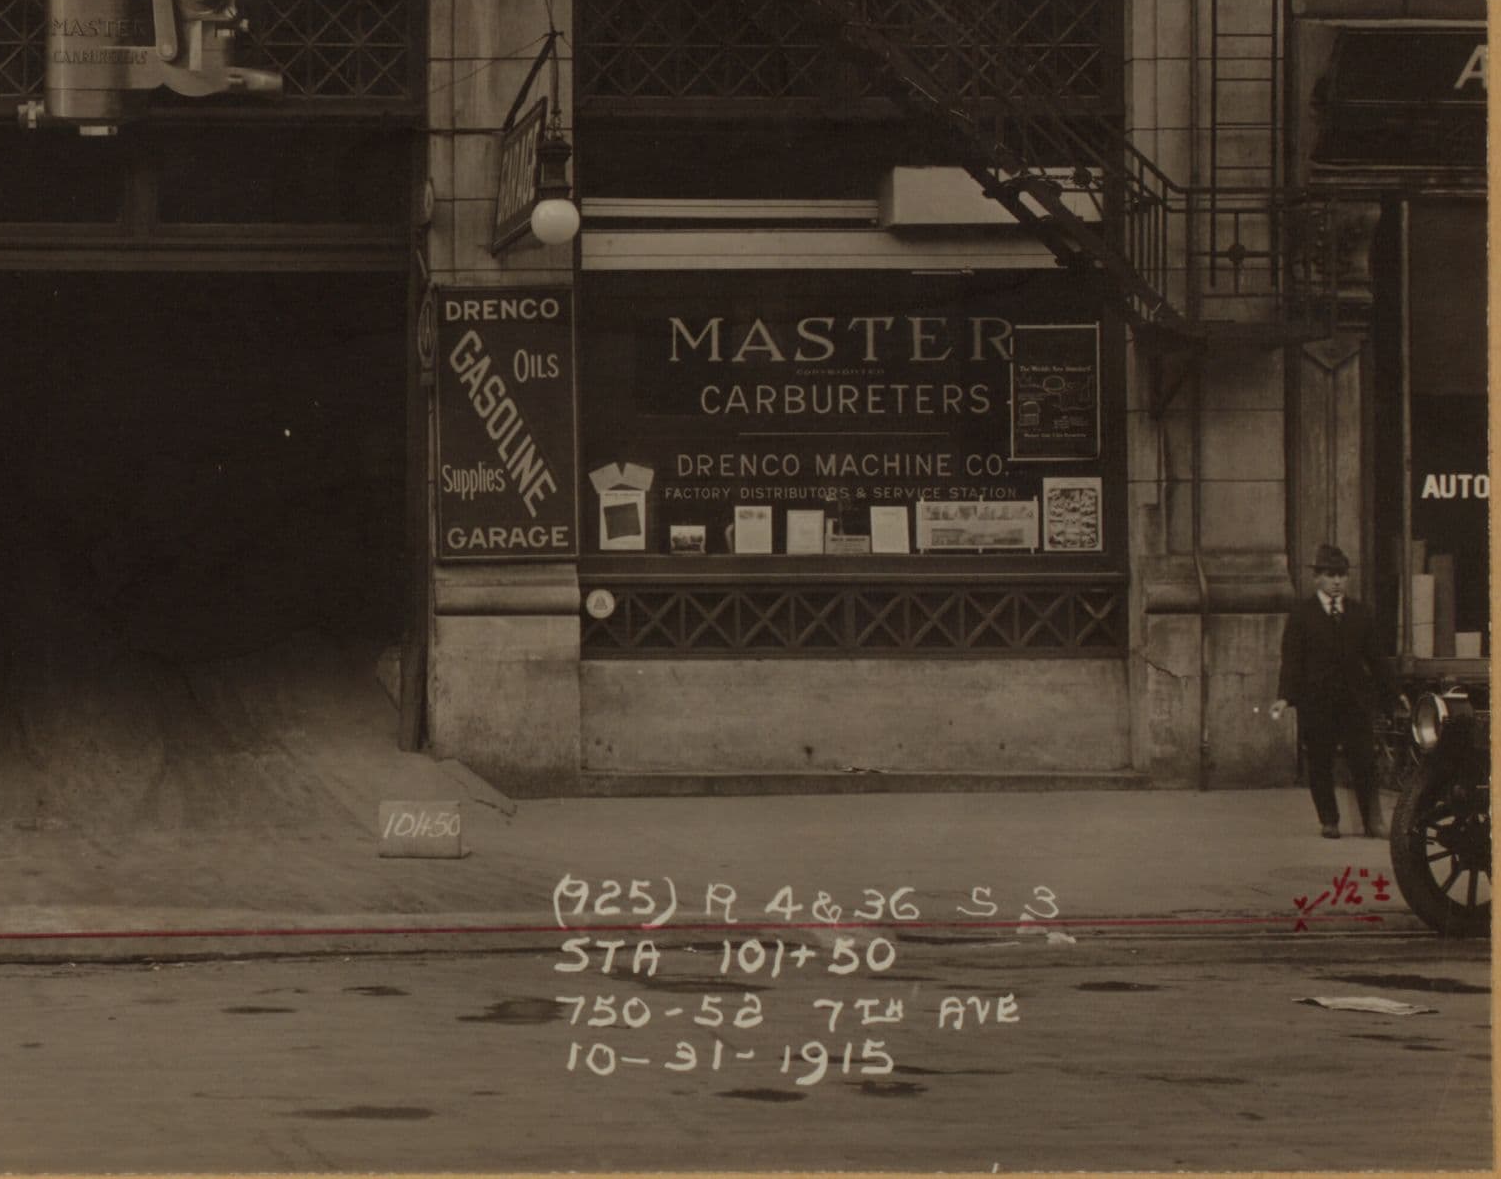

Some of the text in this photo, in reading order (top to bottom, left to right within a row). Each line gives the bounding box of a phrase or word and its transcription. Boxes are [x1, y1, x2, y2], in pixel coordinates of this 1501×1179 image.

[445, 298, 560, 321] DRENCO
[668, 316, 1015, 363] MASTER
[700, 384, 991, 415] CARBURETERS
[449, 329, 558, 519] GASOLINE
[676, 453, 1011, 478] DRENCO MACHINE CO.
[441, 461, 506, 502] Supplies
[665, 486, 1017, 501] FACTORY DISTRIBUTORS & SERVICE STATION
[1421, 474, 1489, 499] AUTO
[447, 526, 569, 550] GARAGE
